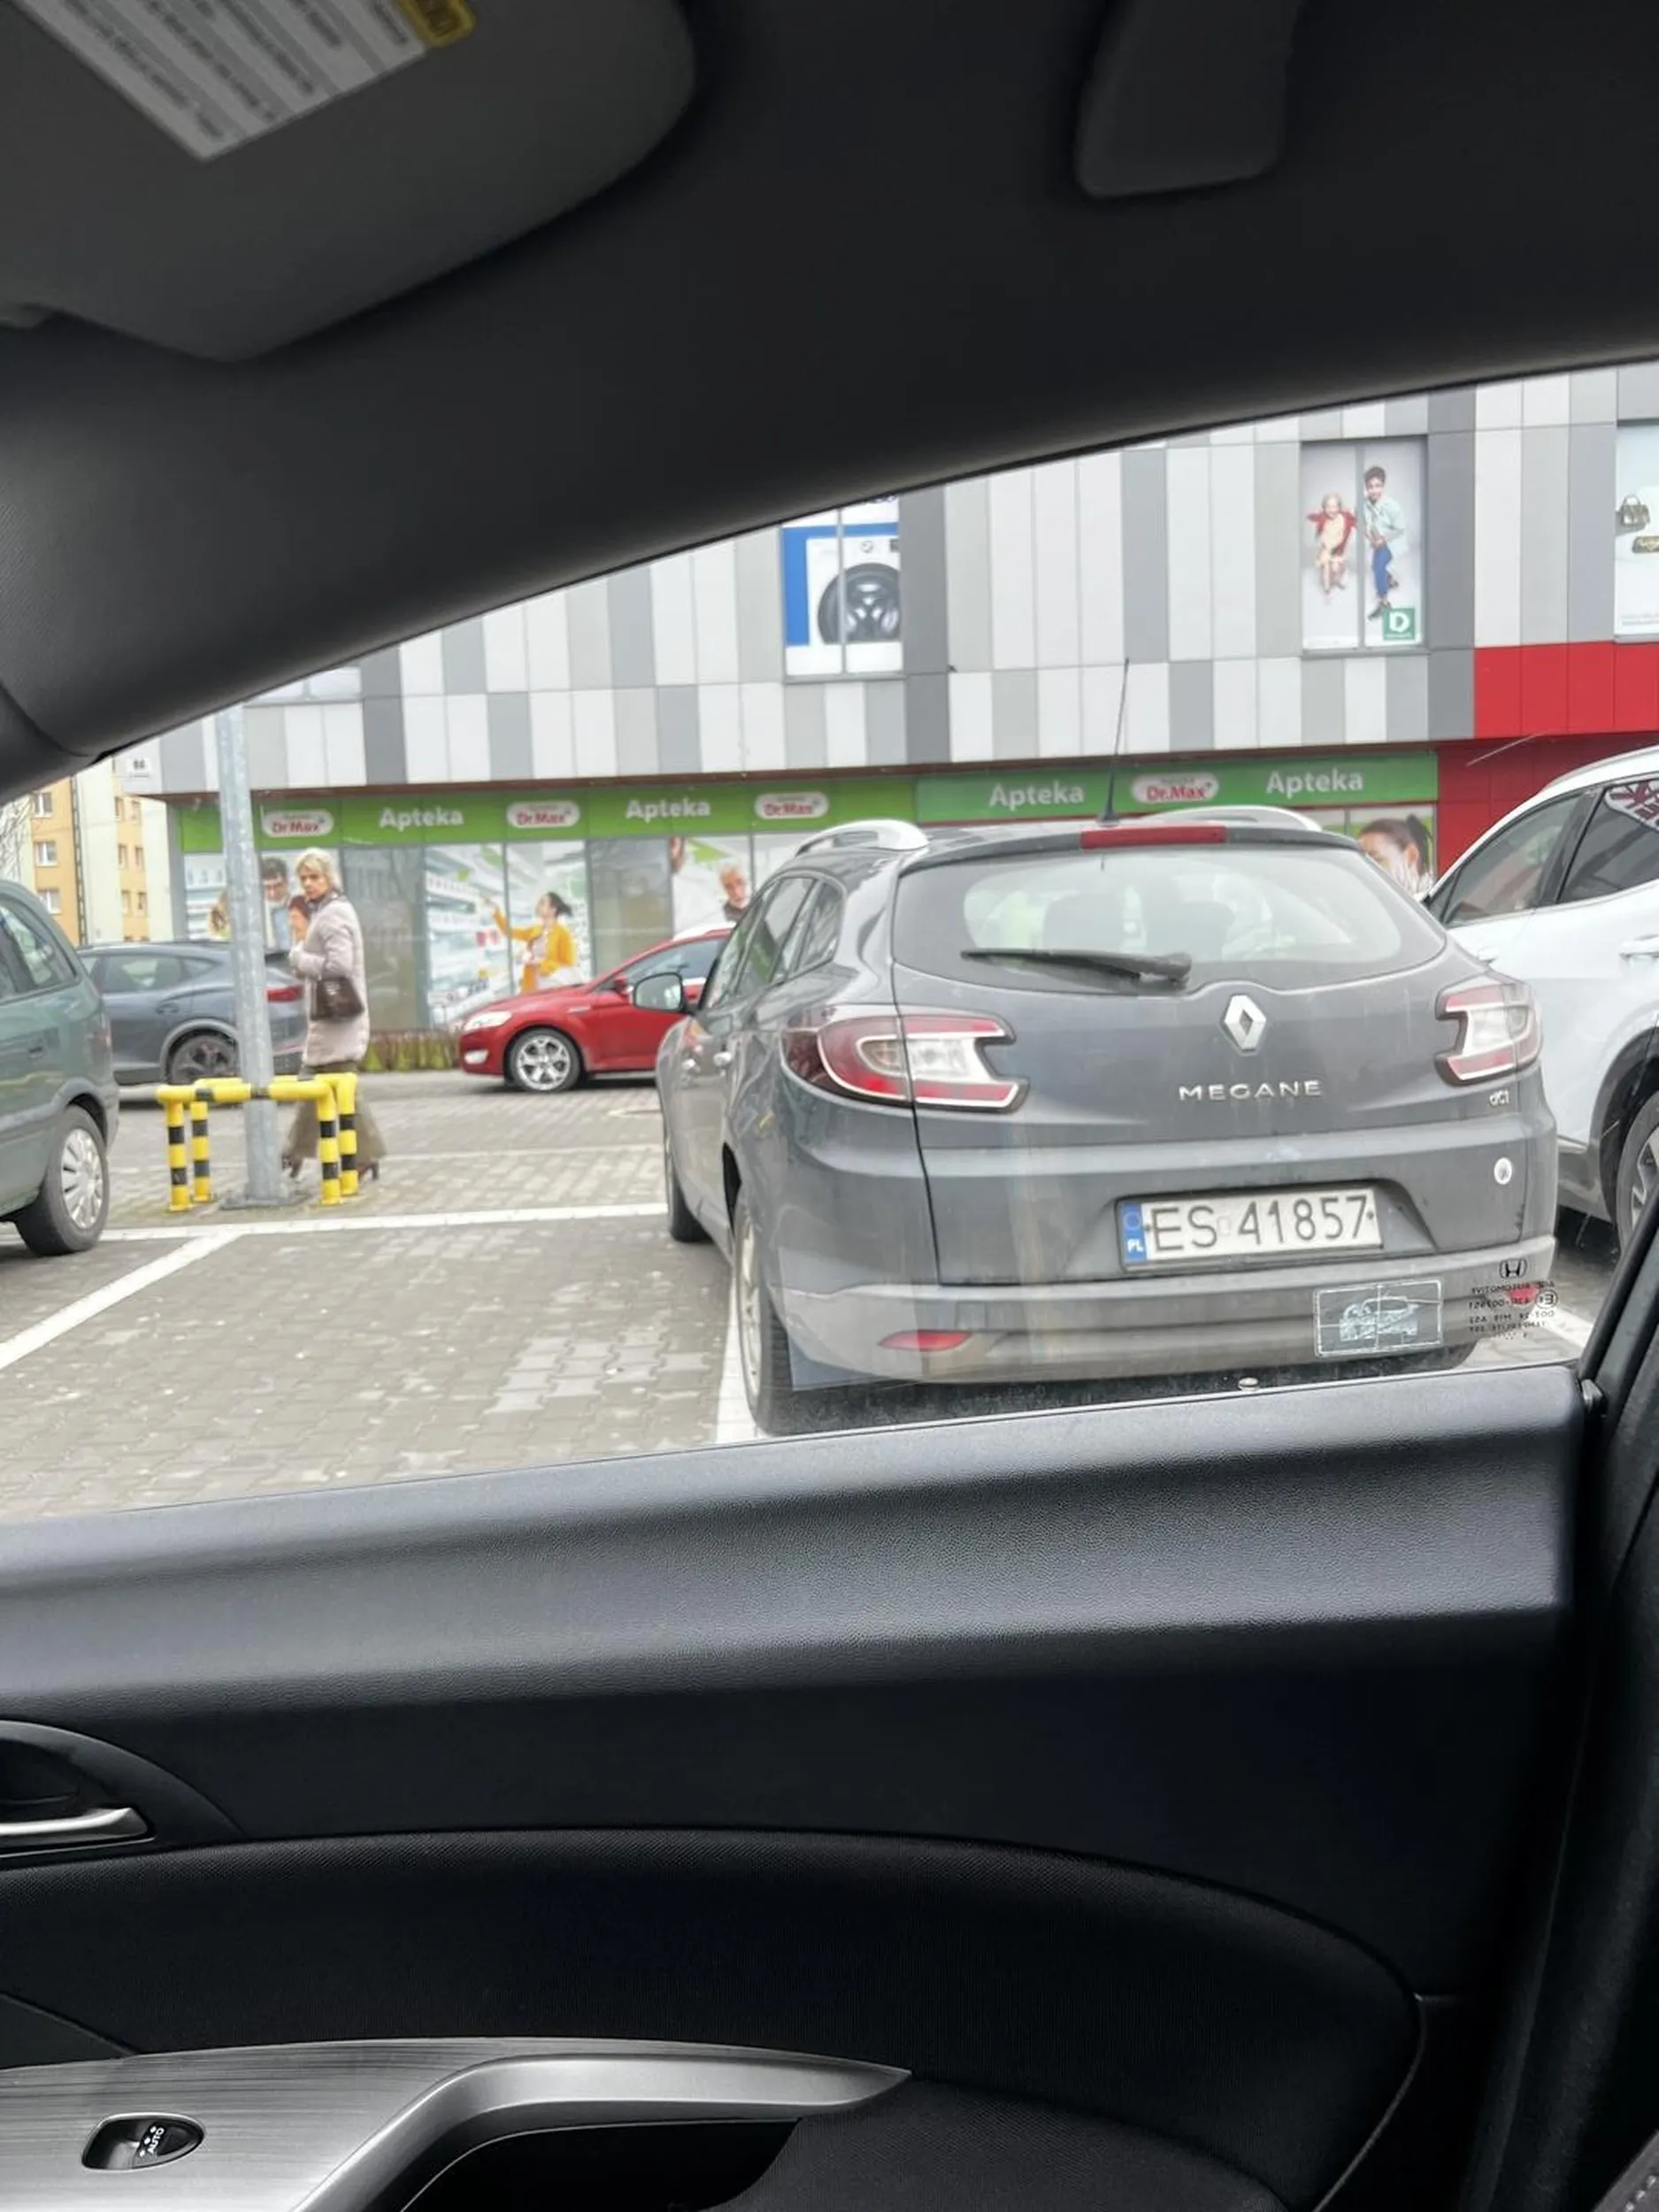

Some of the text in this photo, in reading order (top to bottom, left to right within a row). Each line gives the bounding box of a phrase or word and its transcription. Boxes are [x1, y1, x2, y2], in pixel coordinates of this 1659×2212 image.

[1389, 611, 1410, 633] D
[988, 779, 1085, 813] Apteka
[1146, 785, 1207, 802] Dr.Max
[1265, 767, 1364, 799] Apteka
[380, 806, 465, 832] Apteka
[626, 796, 711, 823] Apteka
[1179, 1079, 1322, 1101] MEGANE
[1151, 1195, 1367, 1252] ES 41857
[1127, 1239, 1144, 1253] PL
[147, 2127, 165, 2154] AUTO
